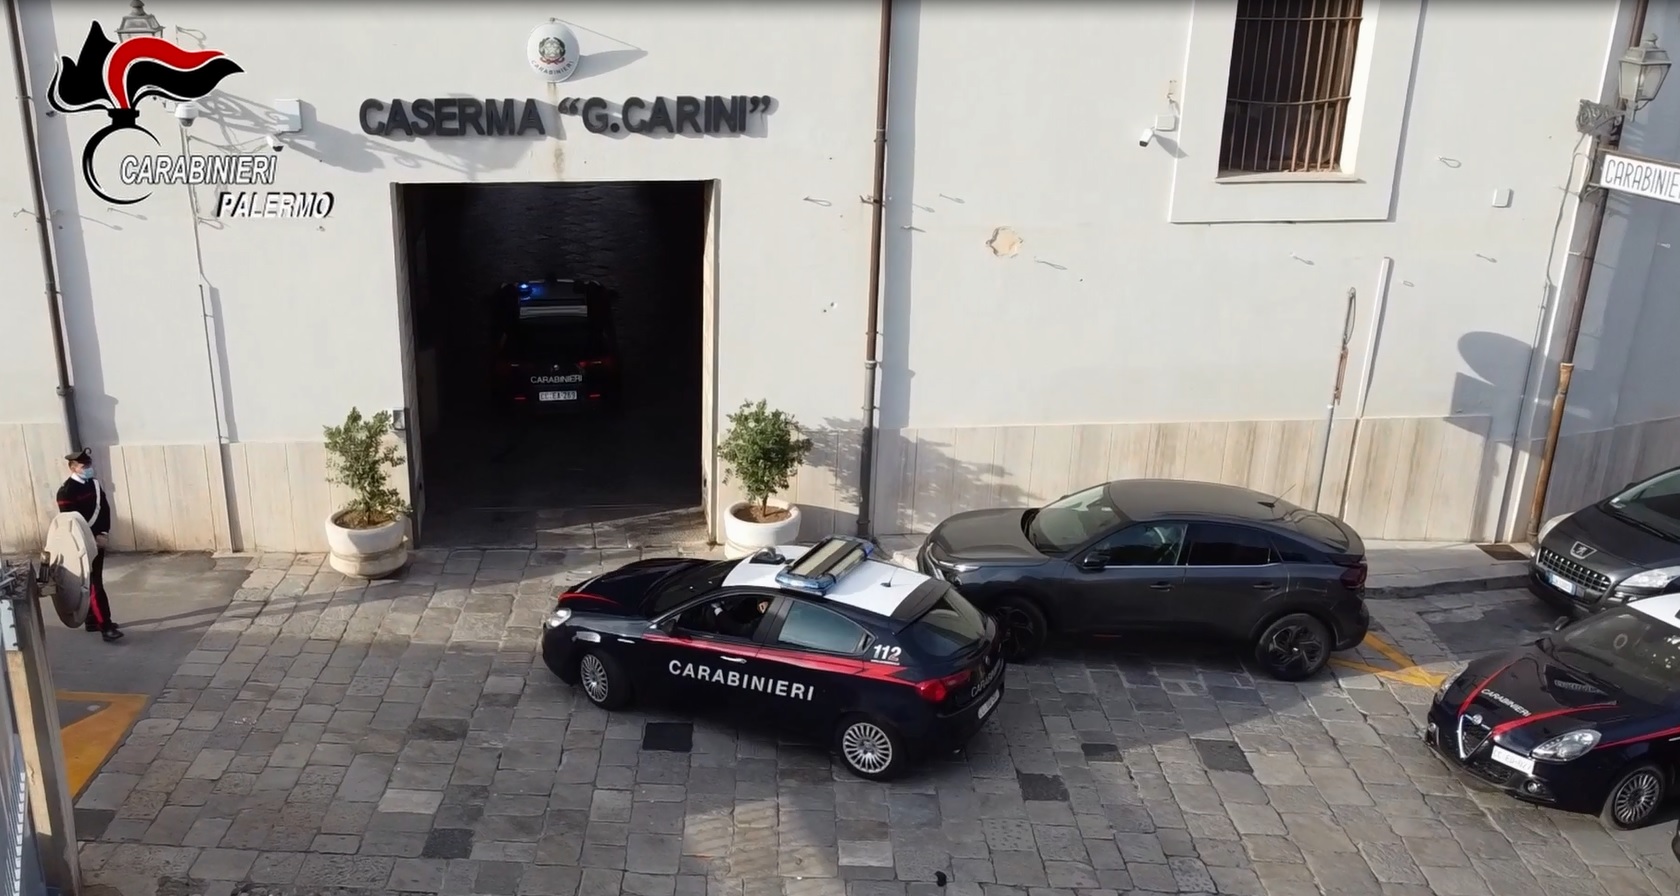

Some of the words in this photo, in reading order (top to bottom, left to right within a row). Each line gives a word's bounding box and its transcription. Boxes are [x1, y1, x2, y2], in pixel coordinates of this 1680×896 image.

[359, 98, 545, 136] CASERMA
[1605, 159, 1680, 199] CARABINIE
[530, 374, 583, 384] CARABINIERI
[873, 644, 902, 662] 112
[669, 660, 814, 701] CARABINIERI
[1481, 689, 1532, 717] CARABINIERI
